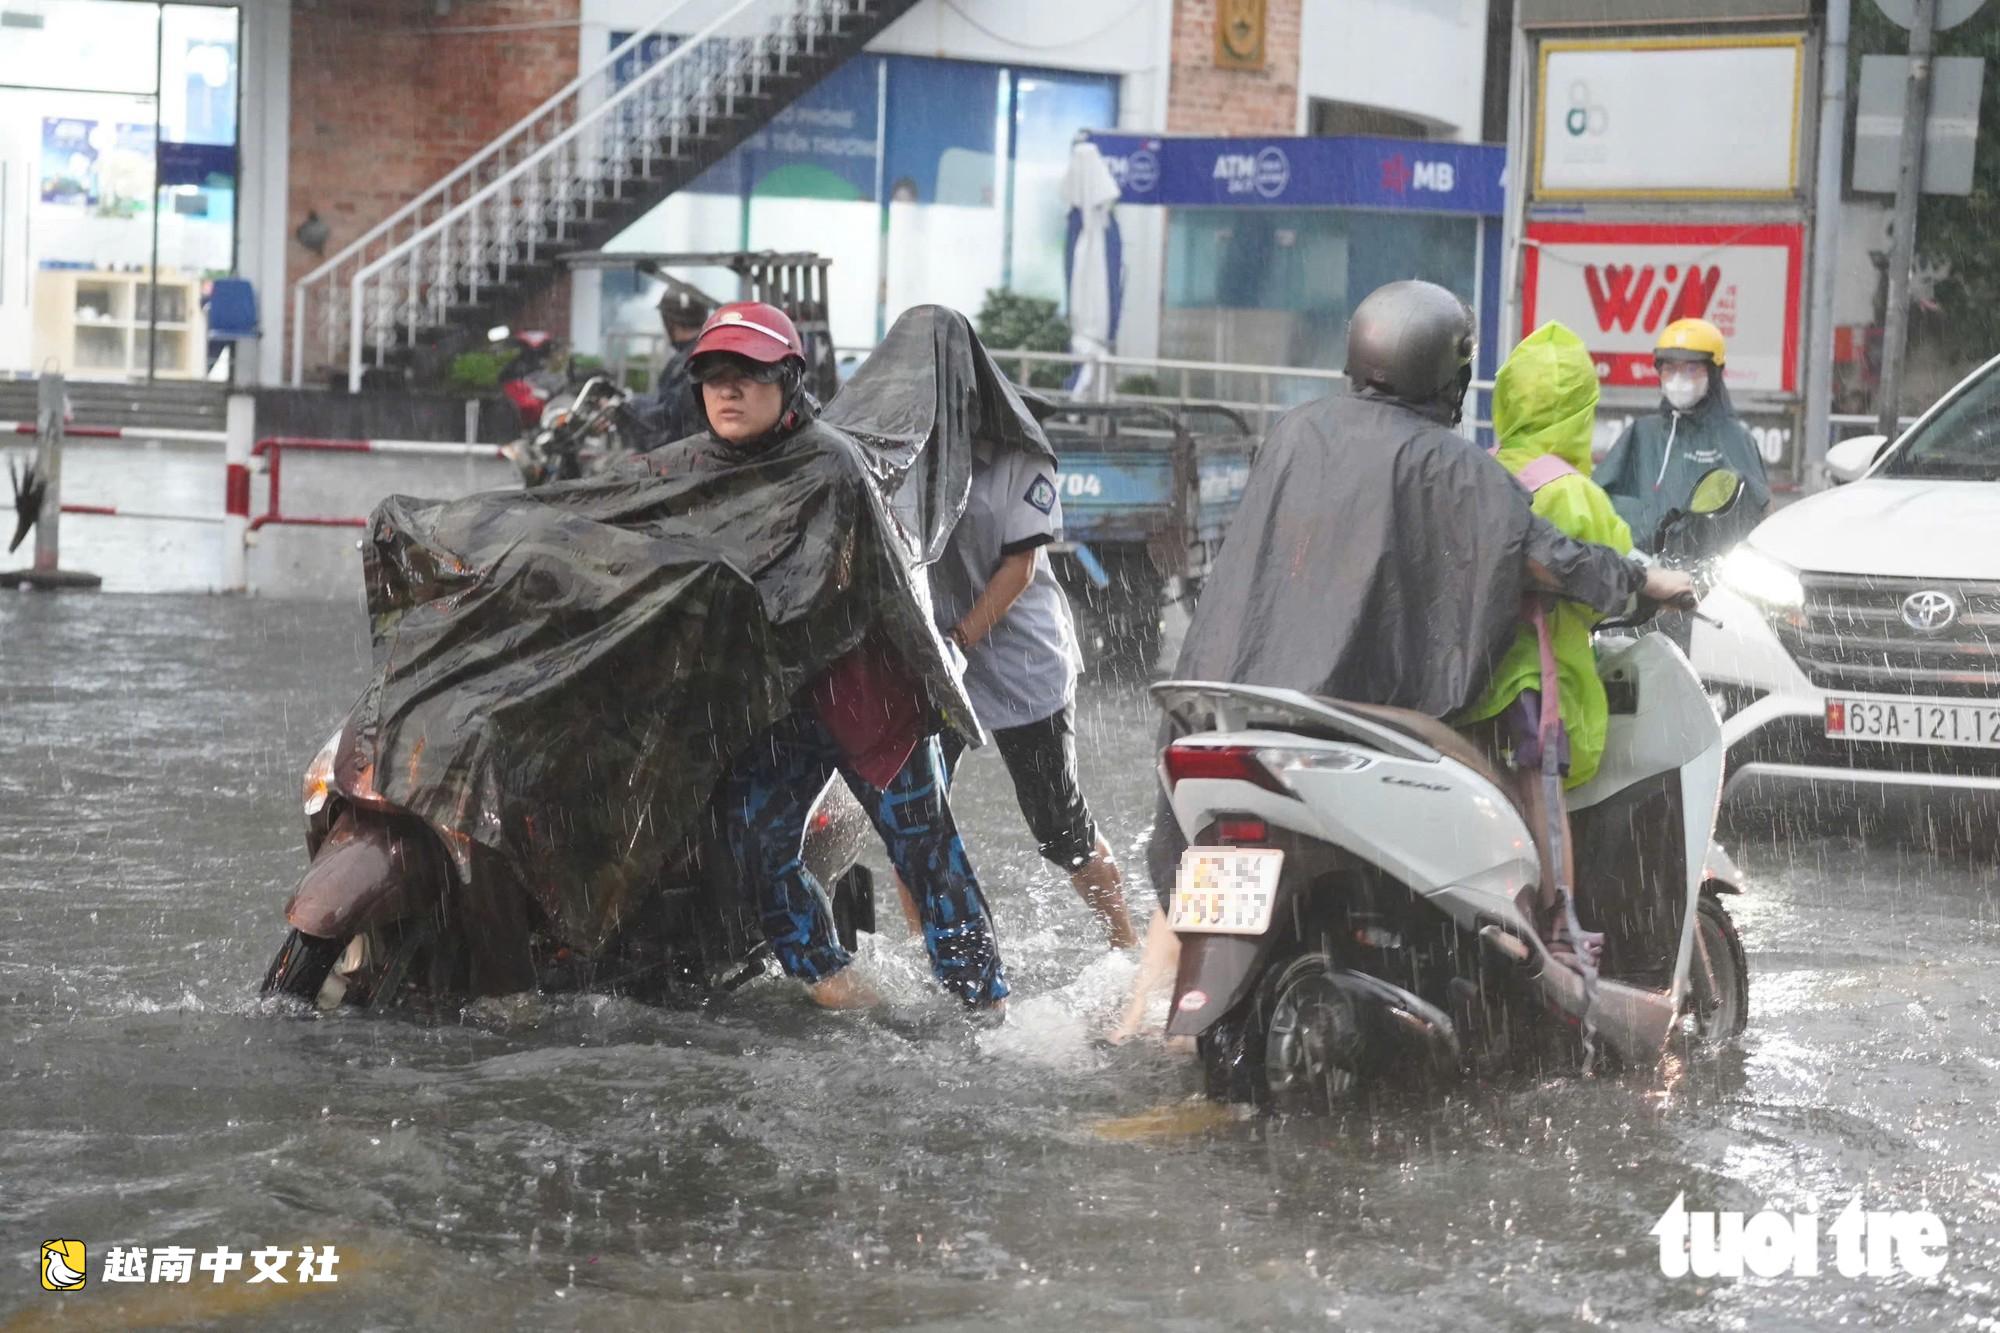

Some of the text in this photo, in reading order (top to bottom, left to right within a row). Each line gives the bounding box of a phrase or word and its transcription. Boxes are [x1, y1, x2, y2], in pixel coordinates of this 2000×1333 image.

[1213, 154, 1255, 178] ATM
[1412, 160, 1455, 192] MB
[1849, 703, 2000, 744] 63A-121.12
